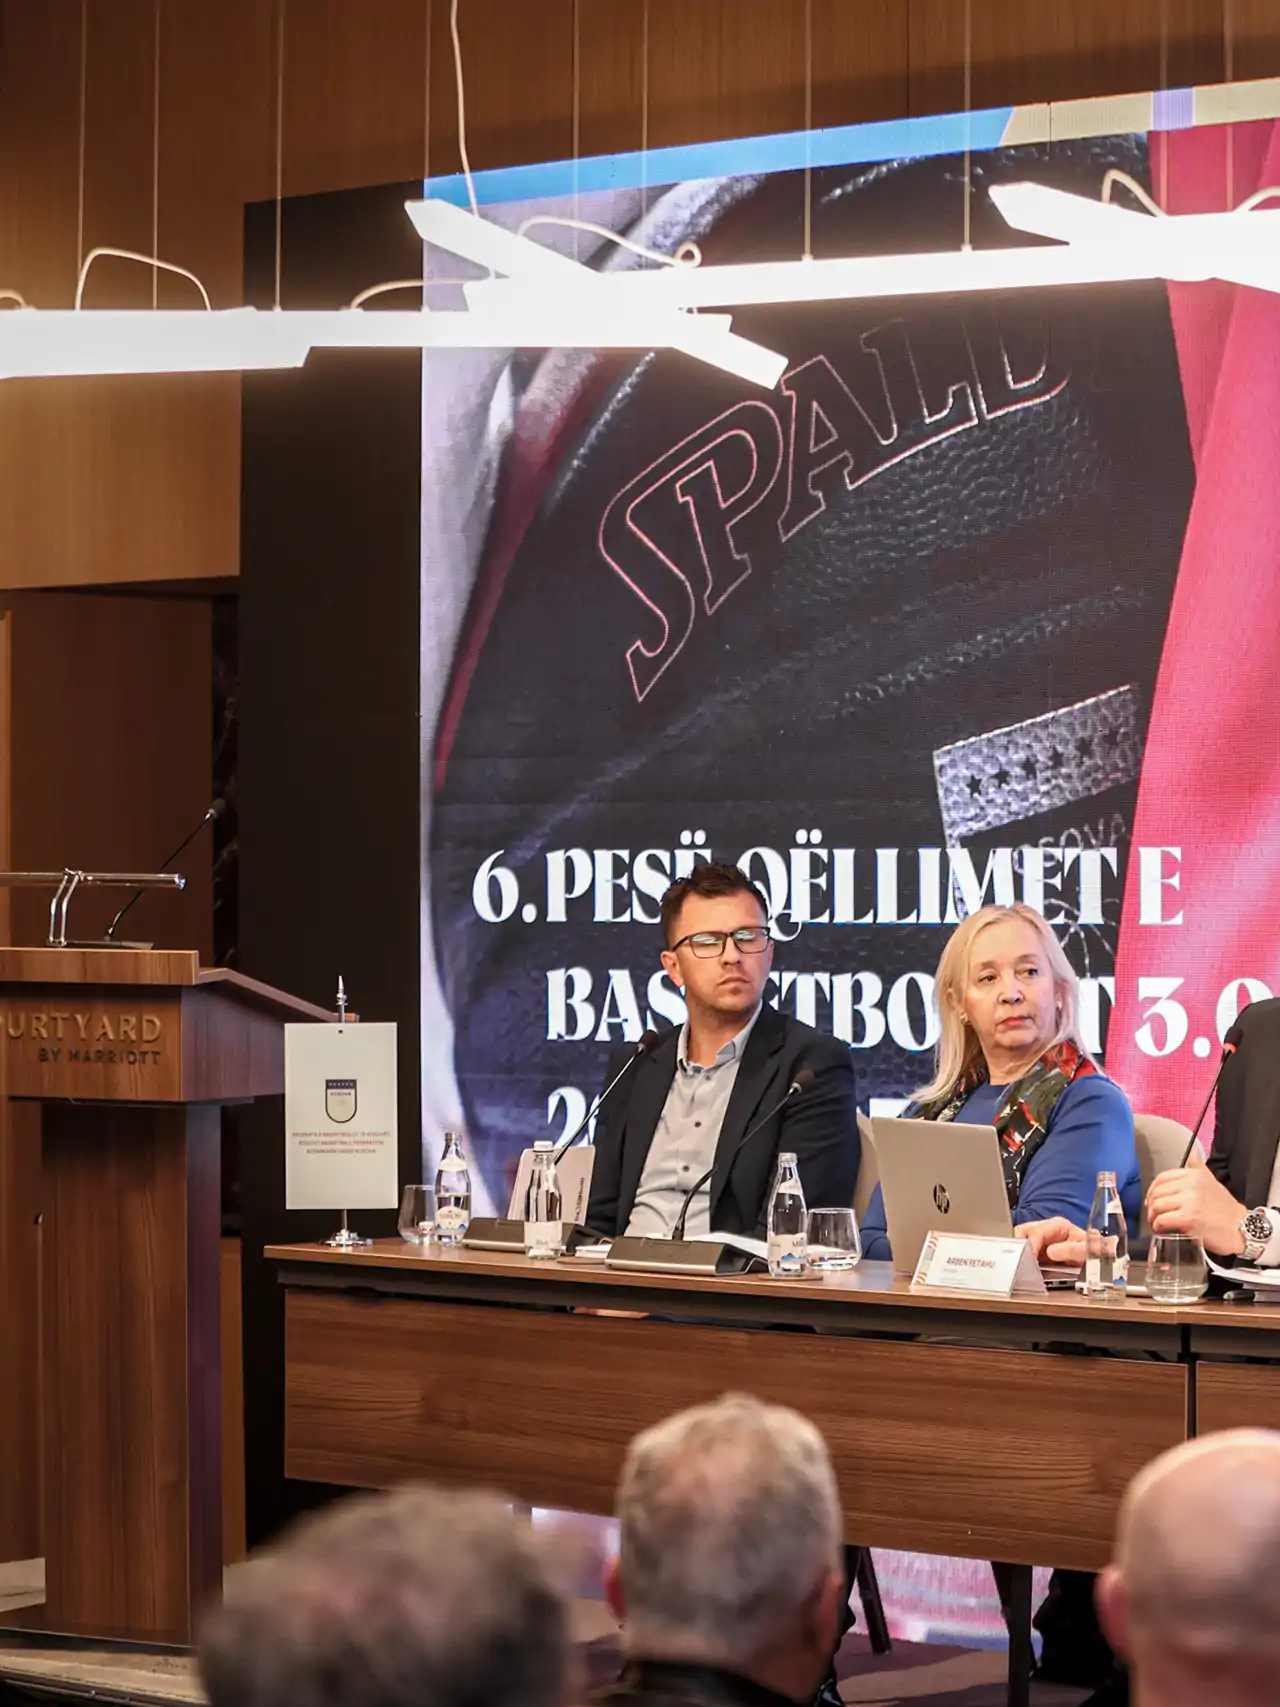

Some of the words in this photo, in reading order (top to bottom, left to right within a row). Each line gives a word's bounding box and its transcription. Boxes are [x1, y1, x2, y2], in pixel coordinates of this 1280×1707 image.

[736, 828, 1118, 941] QËLLIMET
[1138, 846, 1184, 926] E
[0, 1011, 162, 1044] URTYARD
[38, 1047, 62, 1063] BY
[69, 1048, 162, 1066] MARRIOTT
